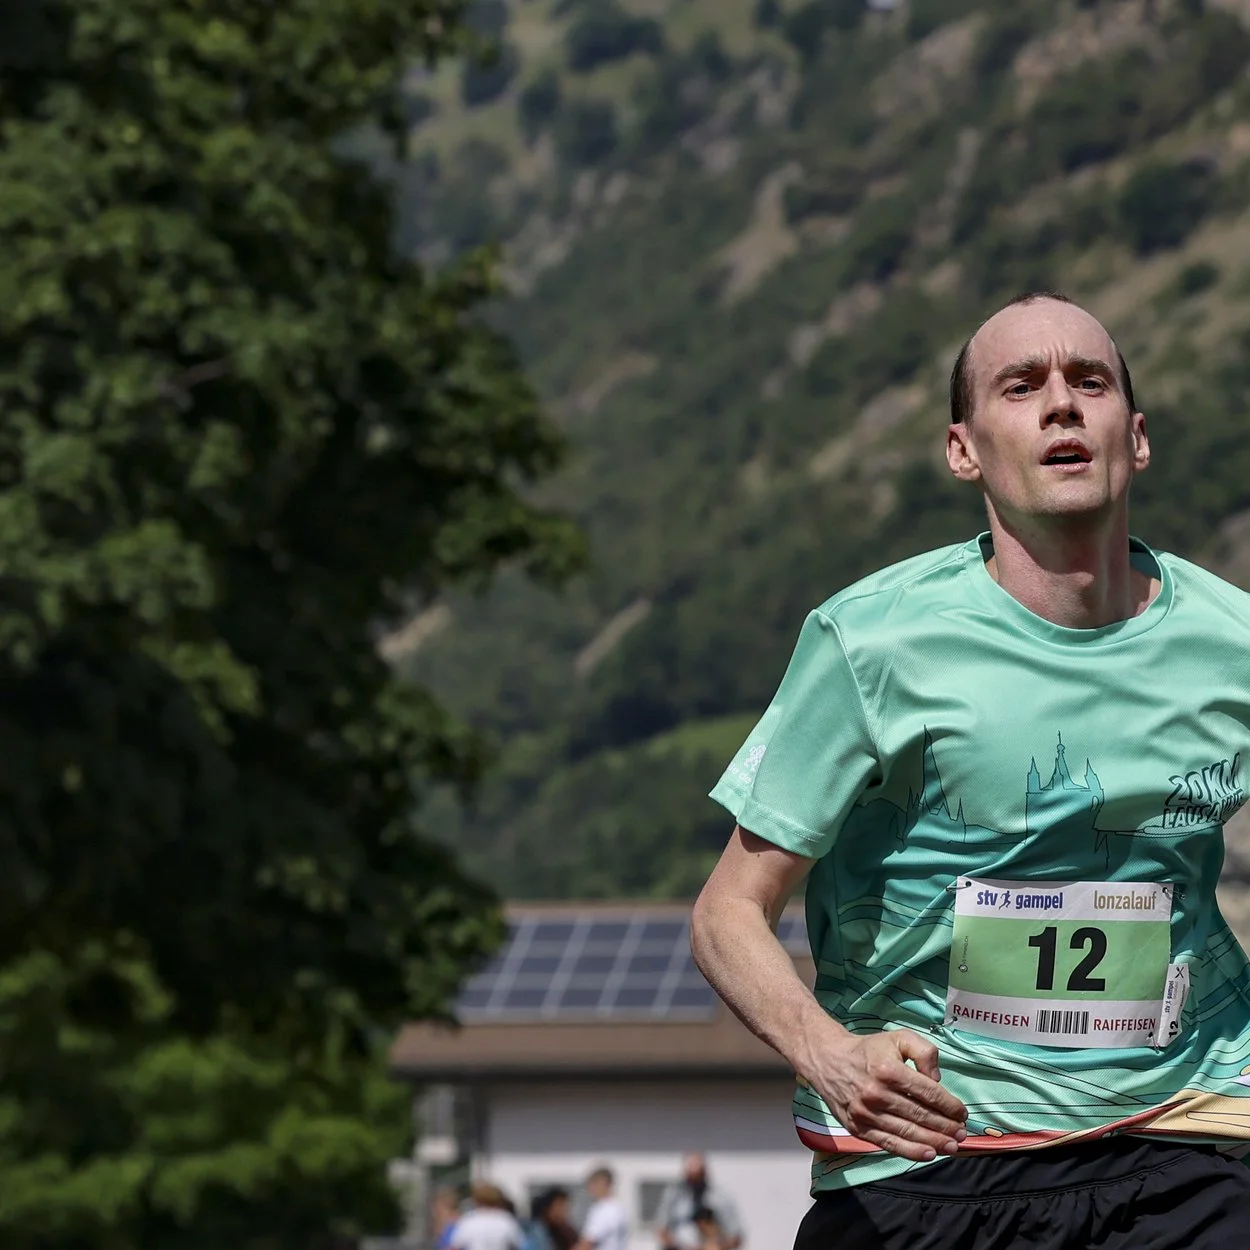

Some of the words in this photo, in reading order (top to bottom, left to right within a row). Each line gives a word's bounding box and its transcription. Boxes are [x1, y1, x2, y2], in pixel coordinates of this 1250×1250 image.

[1165, 752, 1240, 806] 20KM
[977, 890, 998, 906] stv
[1015, 892, 1063, 910] gampel
[1094, 890, 1157, 910] lonzalauf
[1028, 926, 1107, 992] 12
[953, 1004, 1030, 1028] RAIFFEISEN
[1093, 1017, 1156, 1031] RAIFFEISEN
[1168, 1020, 1179, 1038] 12
